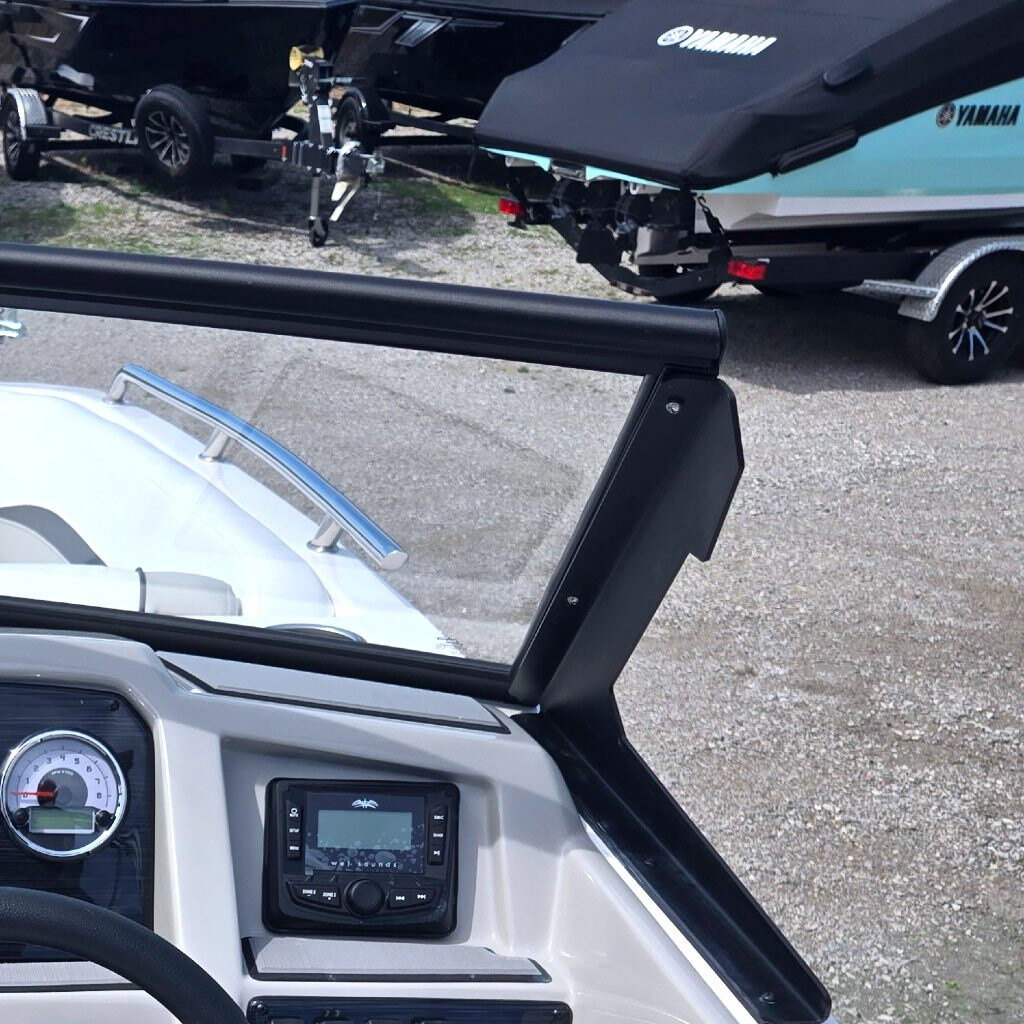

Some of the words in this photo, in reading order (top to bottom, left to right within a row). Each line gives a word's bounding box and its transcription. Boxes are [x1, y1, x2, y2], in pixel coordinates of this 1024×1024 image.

[679, 28, 777, 55] YAMAHA
[956, 104, 1021, 126] YAMAHA
[88, 124, 138, 145] CRESTL
